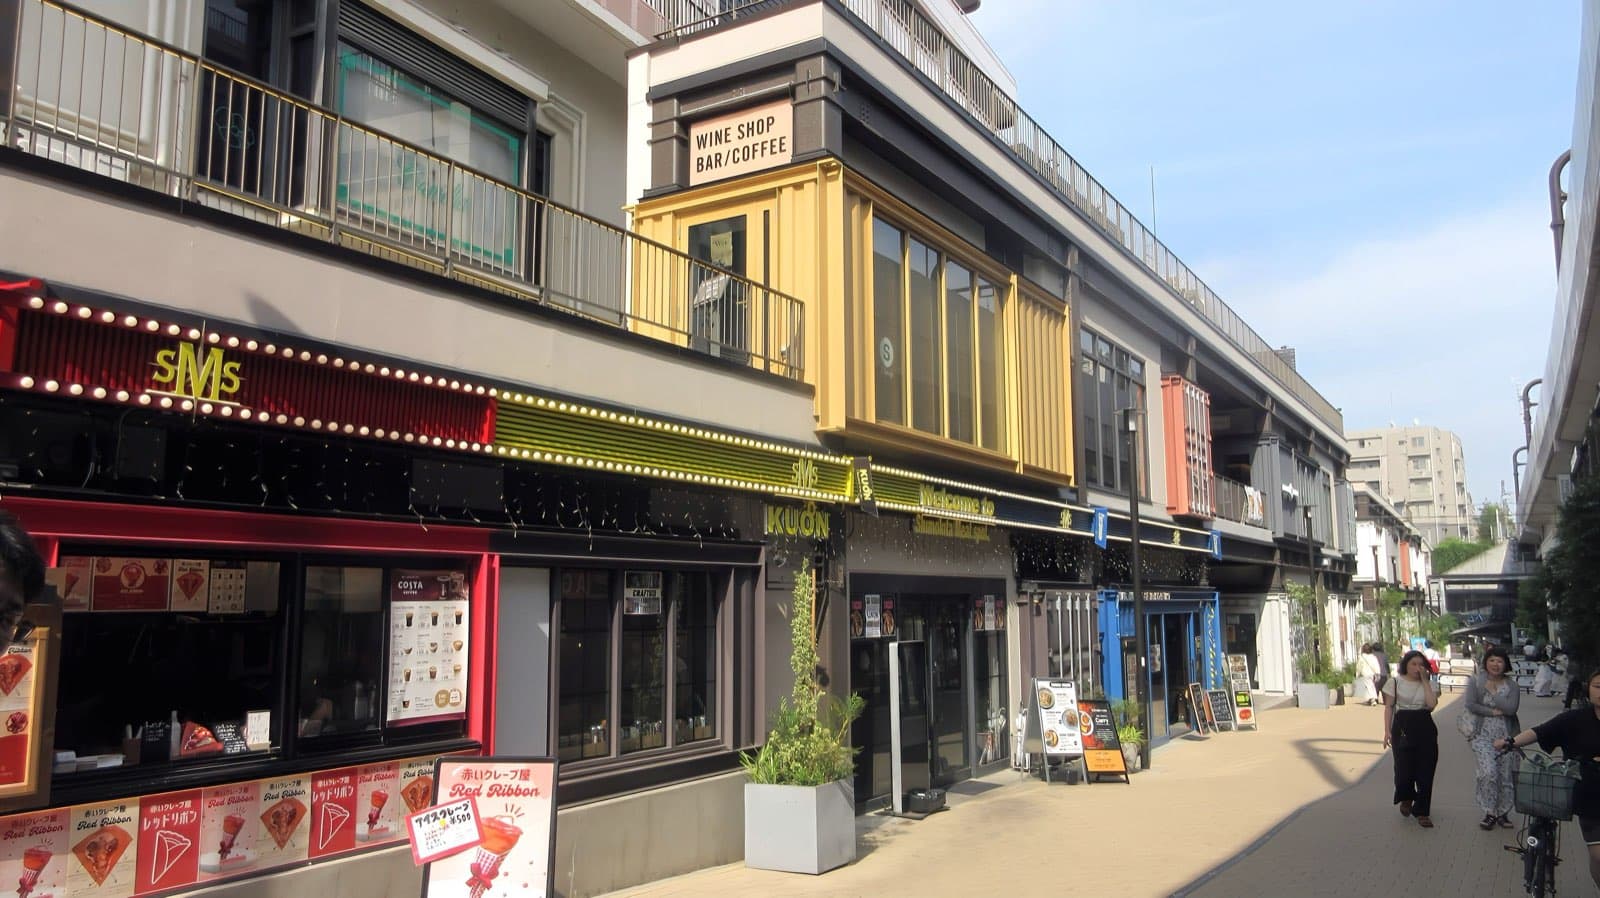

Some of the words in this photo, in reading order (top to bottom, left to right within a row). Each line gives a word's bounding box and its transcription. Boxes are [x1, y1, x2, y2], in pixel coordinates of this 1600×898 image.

[697, 127, 731, 150] WINE
[737, 116, 775, 140] SHOP
[696, 136, 787, 173] BAR/COFFEE
[920, 484, 980, 514] Welcome
[981, 496, 995, 516] to
[767, 505, 832, 539] KUON
[398, 580, 423, 590] COSTA
[461, 768, 530, 781] 赤いクレープ屋
[263, 791, 280, 801] Red
[281, 788, 306, 799] Ribbon
[449, 783, 482, 797] Red
[486, 783, 541, 798] Ribbon
[207, 799, 225, 809] Red
[77, 820, 98, 831] Red
[100, 815, 131, 827] Ribbon
[449, 812, 471, 825] ¥500
[3, 830, 25, 840] Red
[29, 824, 63, 837] Ribbon
